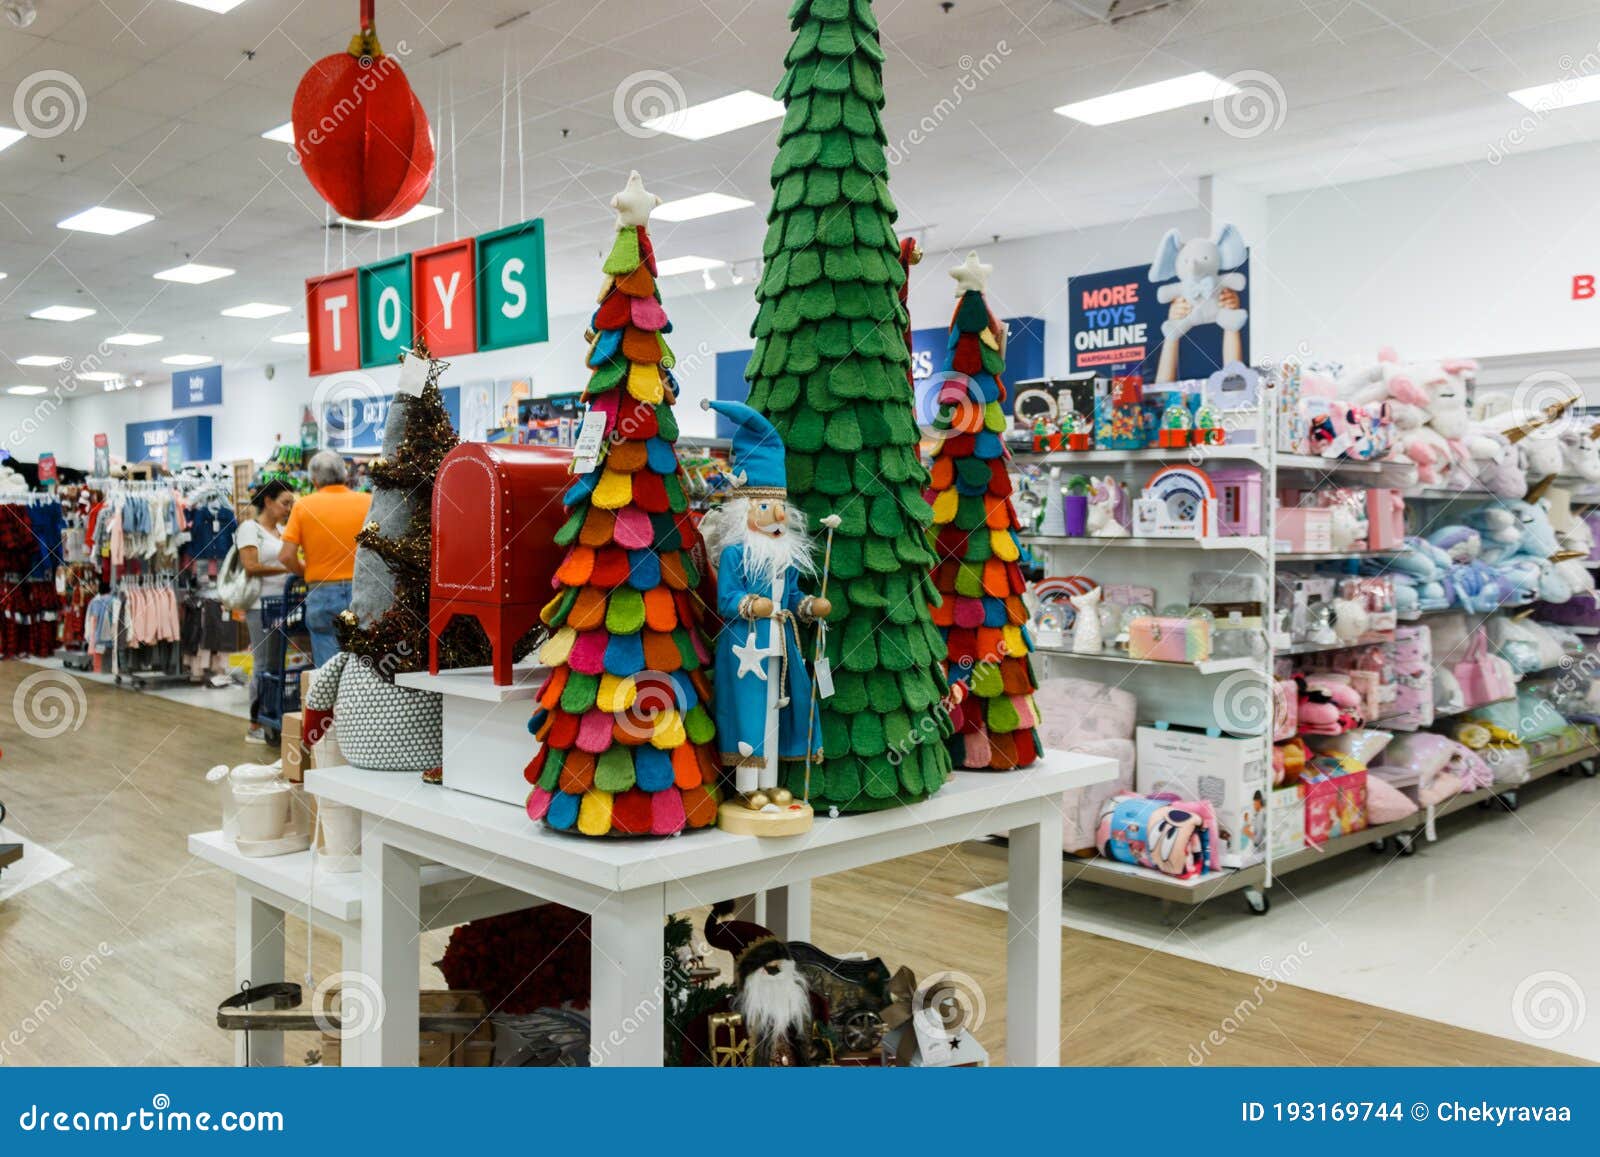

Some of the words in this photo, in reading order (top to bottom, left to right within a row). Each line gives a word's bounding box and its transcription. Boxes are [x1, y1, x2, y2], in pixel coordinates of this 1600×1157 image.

[1082, 283, 1139, 310] MORE
[1572, 275, 1595, 300] B
[324, 257, 527, 352] TOYS
[1085, 305, 1136, 329] TOYS
[1074, 323, 1147, 351] ONLINE
